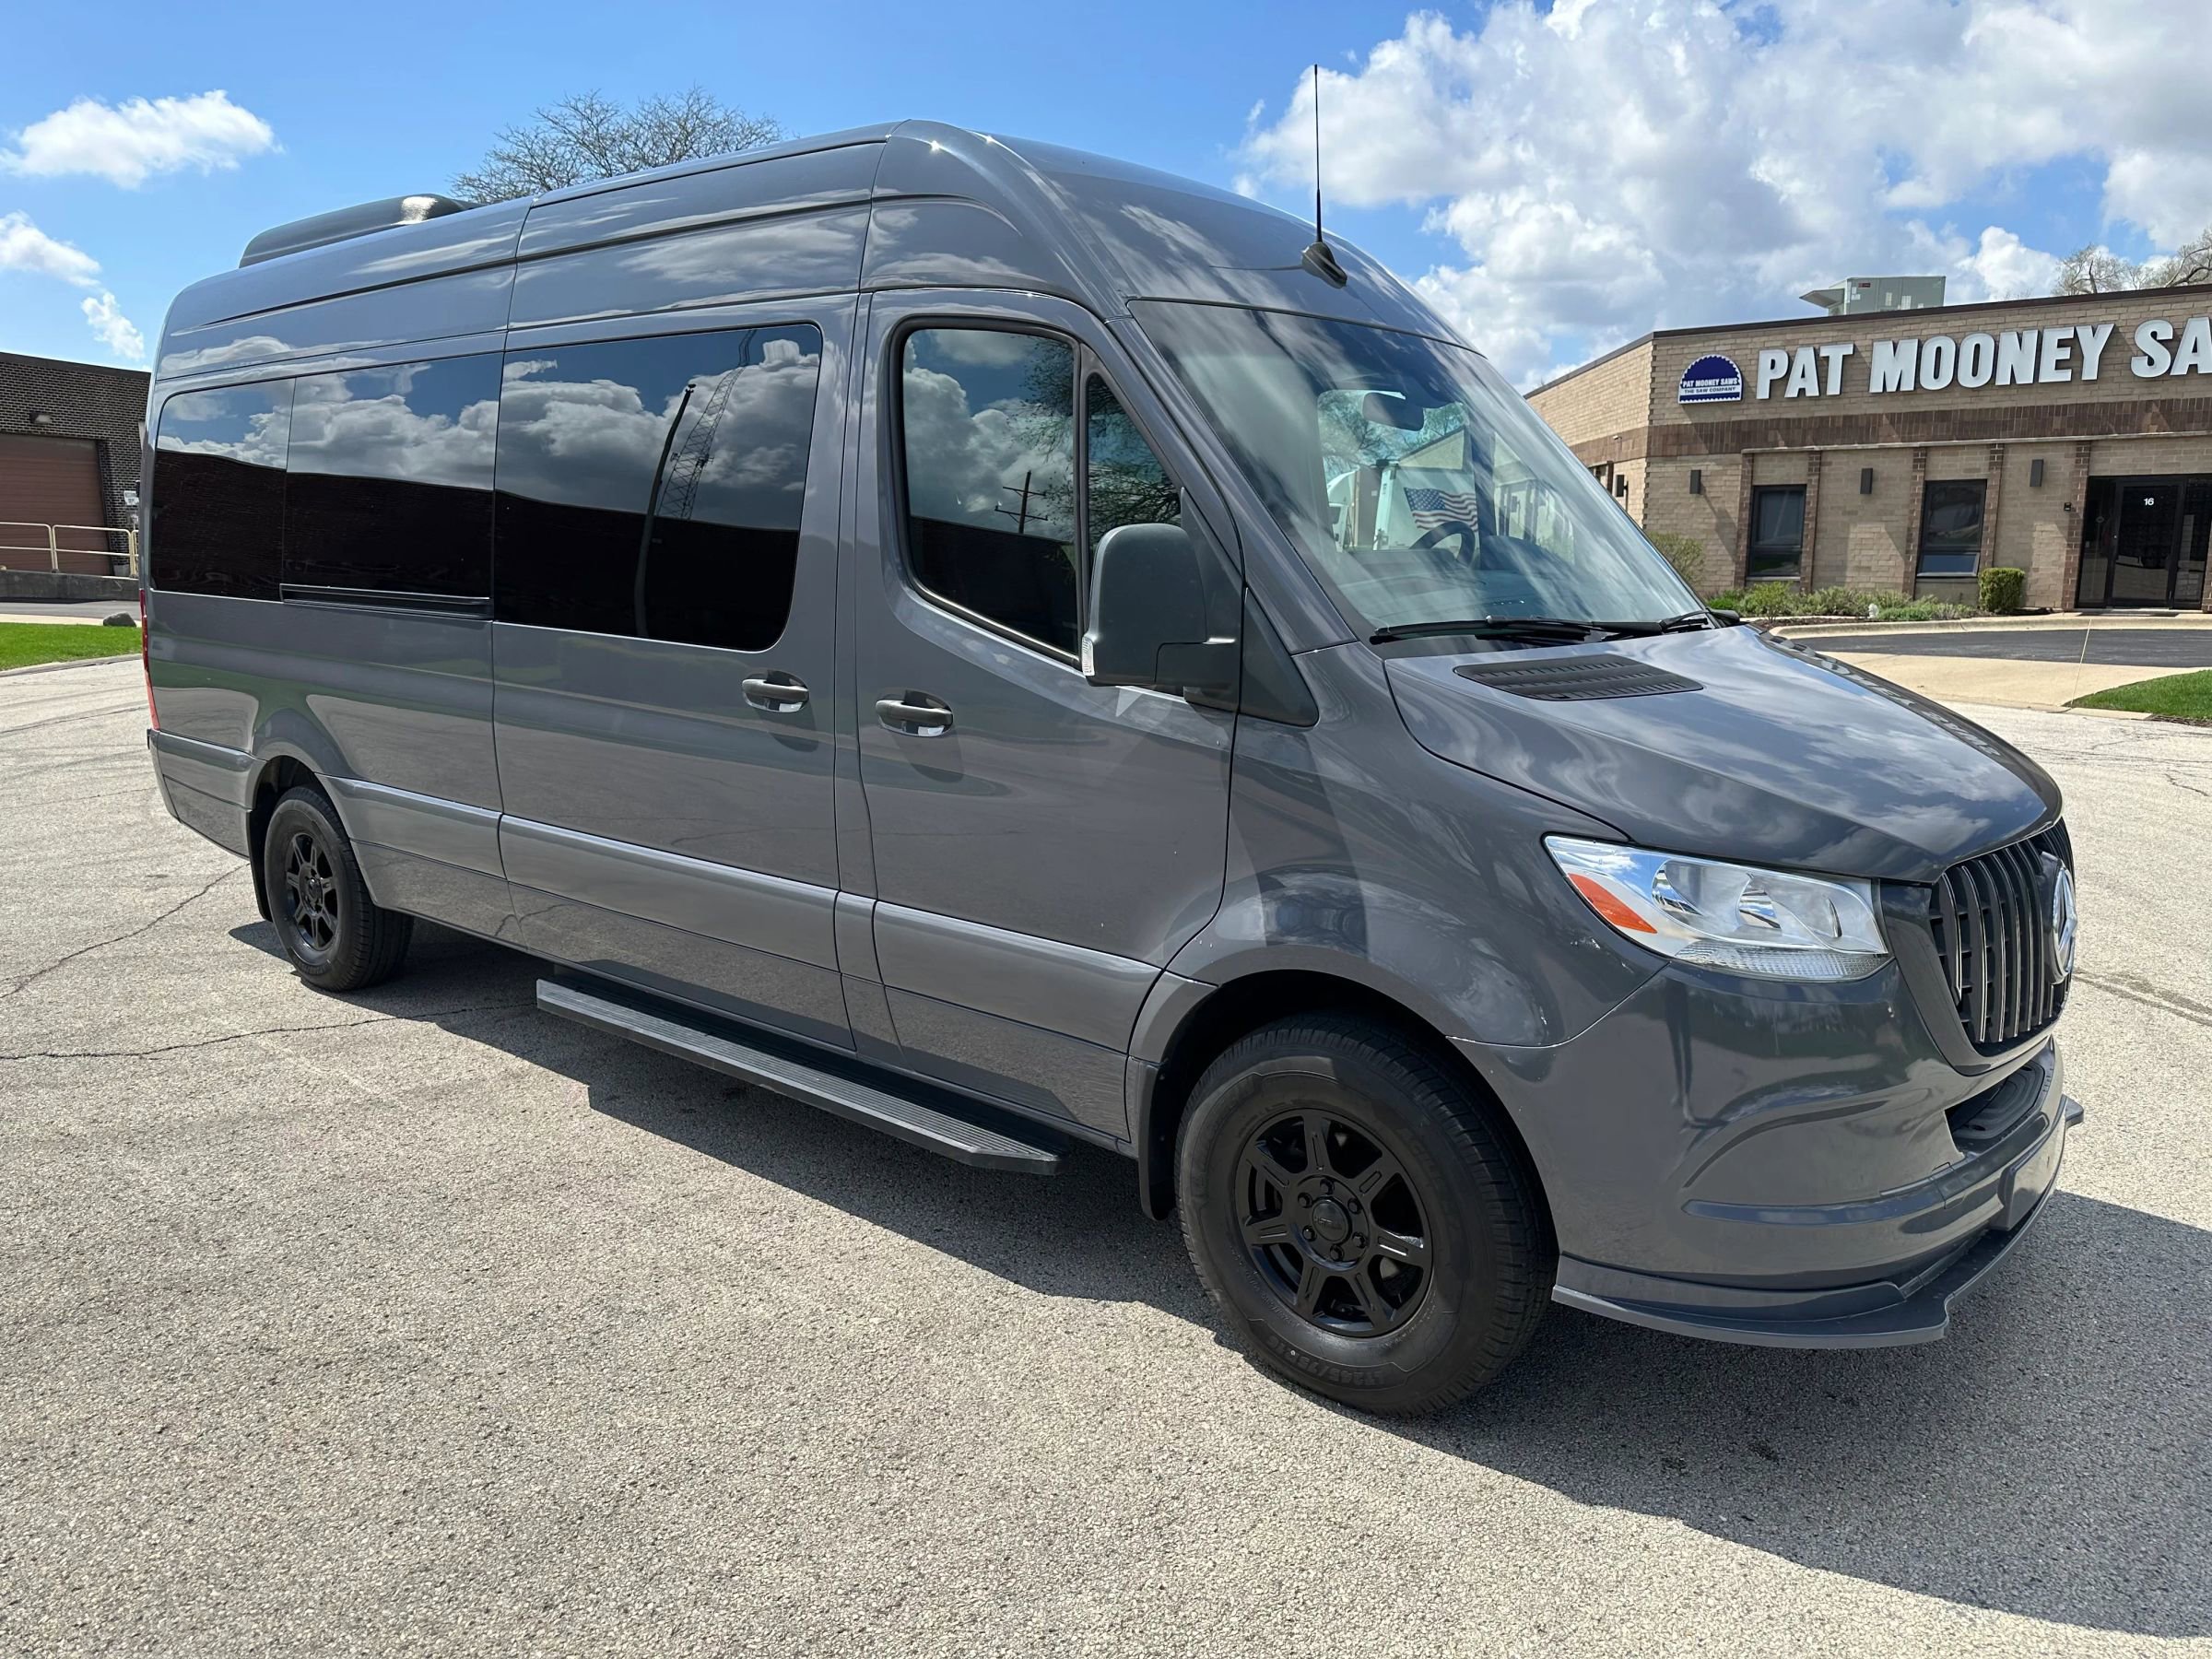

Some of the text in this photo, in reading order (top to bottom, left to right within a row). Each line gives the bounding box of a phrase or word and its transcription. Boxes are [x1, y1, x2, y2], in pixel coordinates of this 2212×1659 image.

[1756, 316, 2212, 400] PAT MOONEY SA
[2144, 498, 2154, 506] 16
